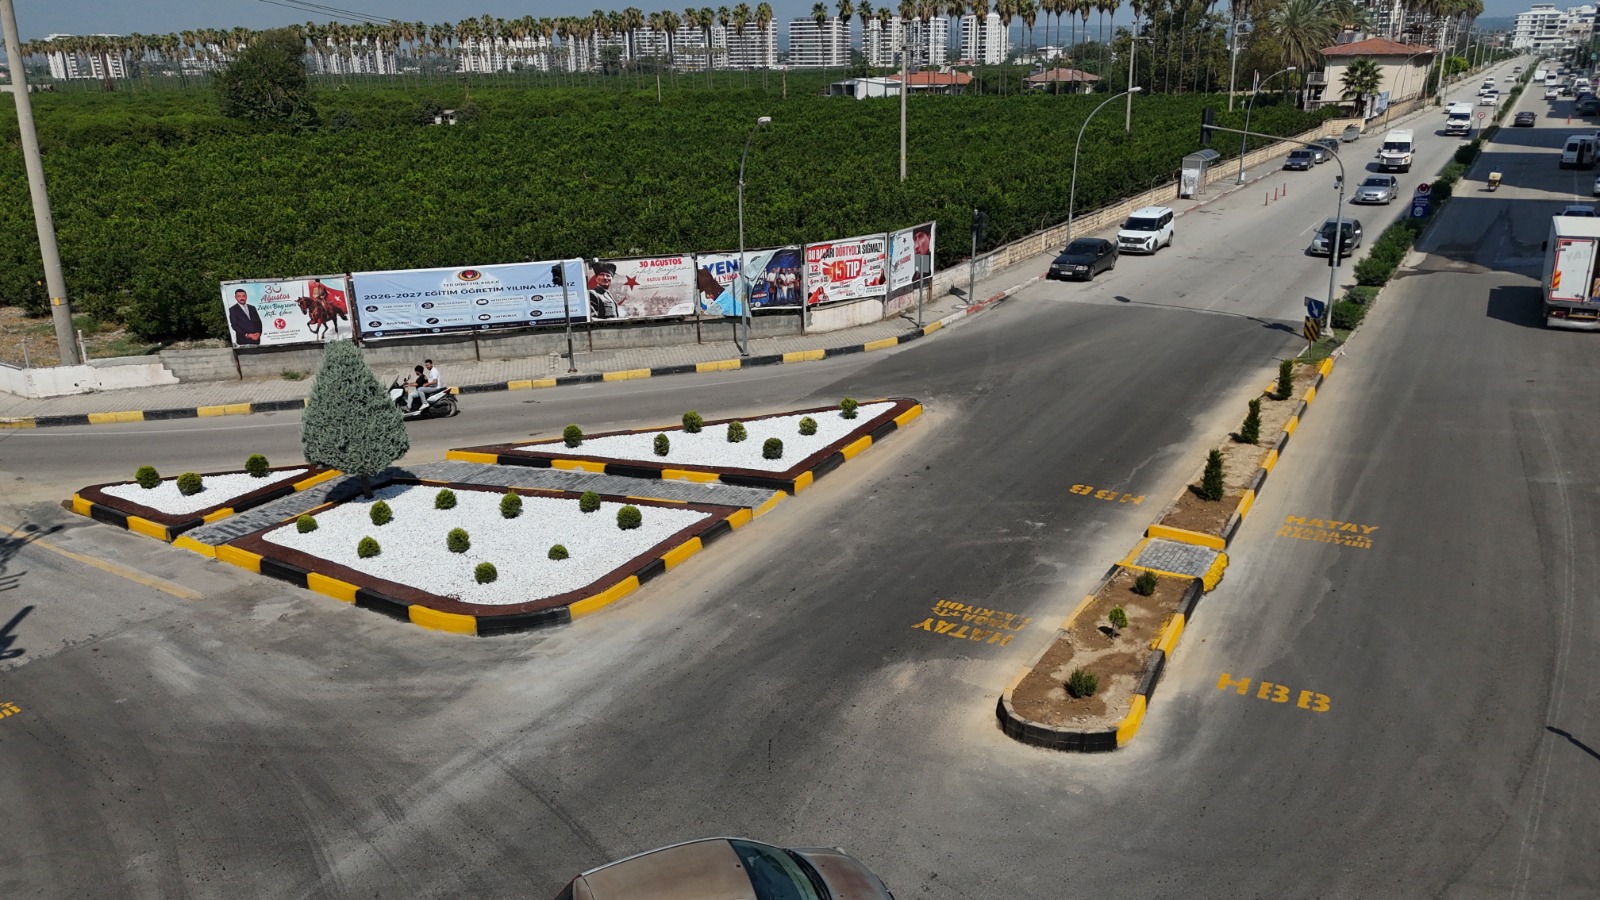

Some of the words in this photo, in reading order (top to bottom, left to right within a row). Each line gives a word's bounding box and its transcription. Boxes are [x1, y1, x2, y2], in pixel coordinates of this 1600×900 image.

[640, 260, 648, 268] 30
[650, 258, 682, 267] AĞUSTOS
[832, 260, 846, 282] 15
[846, 260, 860, 278] TIP
[1286, 515, 1380, 534] HATAY
[911, 618, 1014, 647] HATAY
[1216, 672, 1331, 712] HBB
